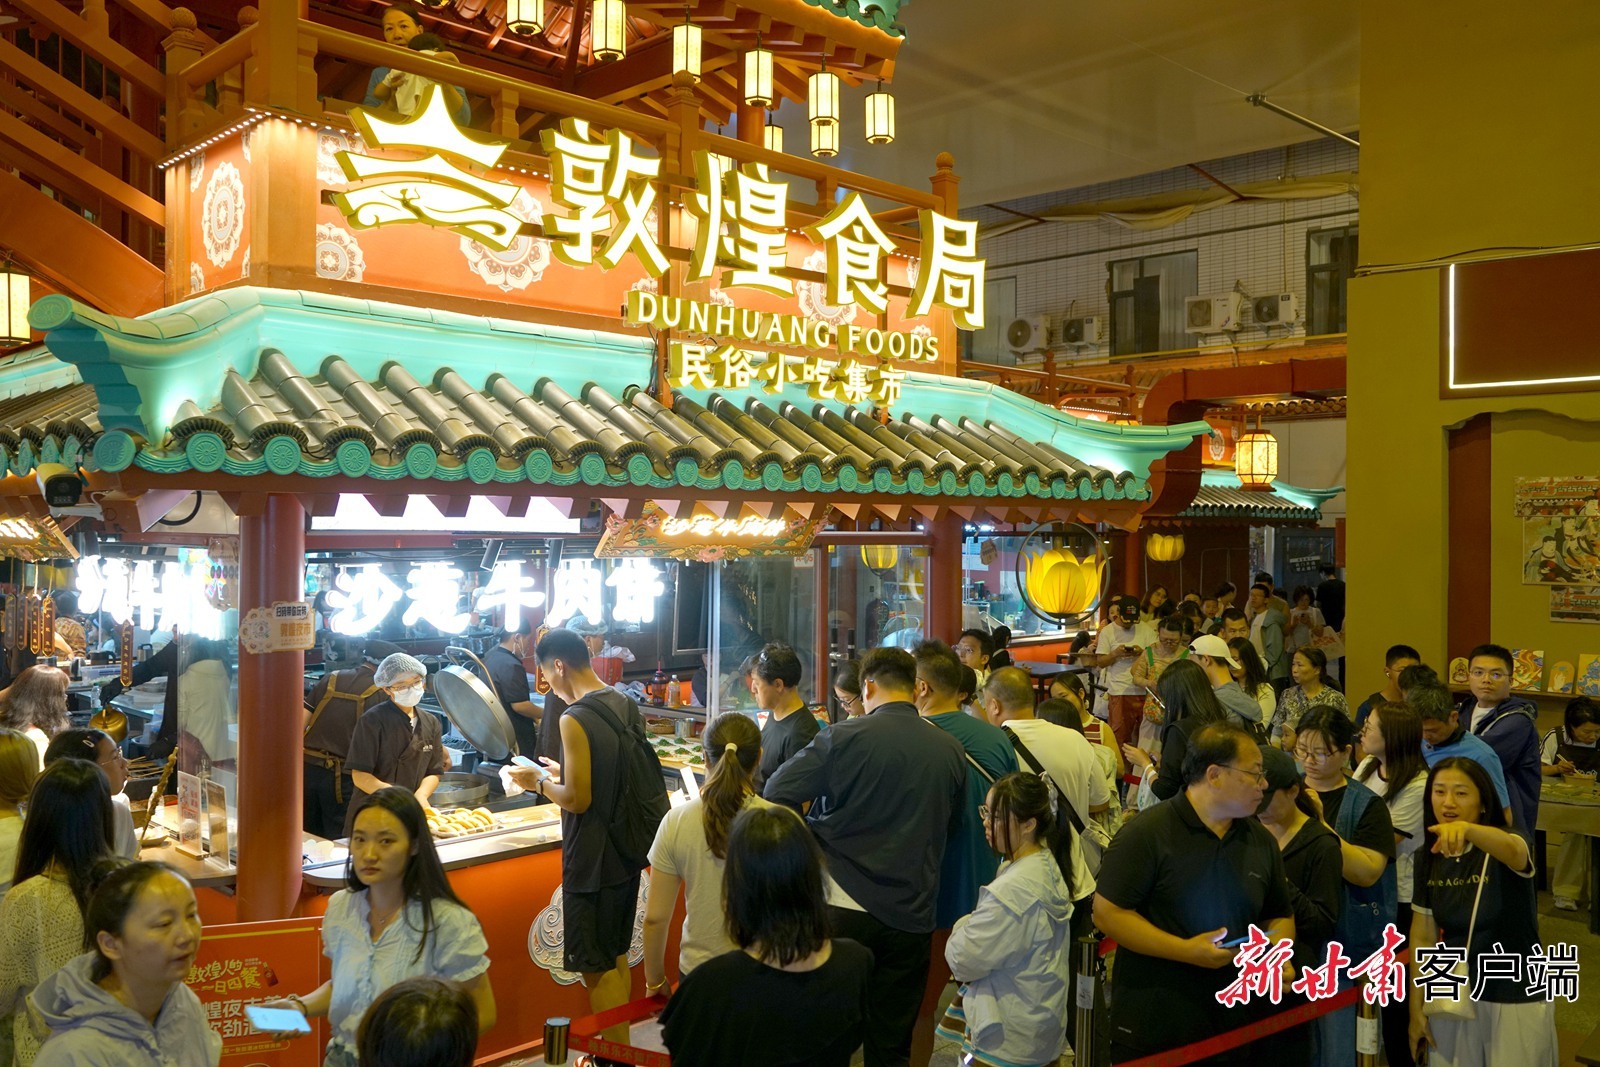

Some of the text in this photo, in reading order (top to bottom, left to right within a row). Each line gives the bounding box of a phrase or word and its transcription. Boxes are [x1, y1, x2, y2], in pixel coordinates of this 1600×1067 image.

[546, 118, 987, 329] 敦煌食局
[637, 292, 939, 361] DUNHUANG FOODS
[678, 343, 906, 407] 民俗小吃集市
